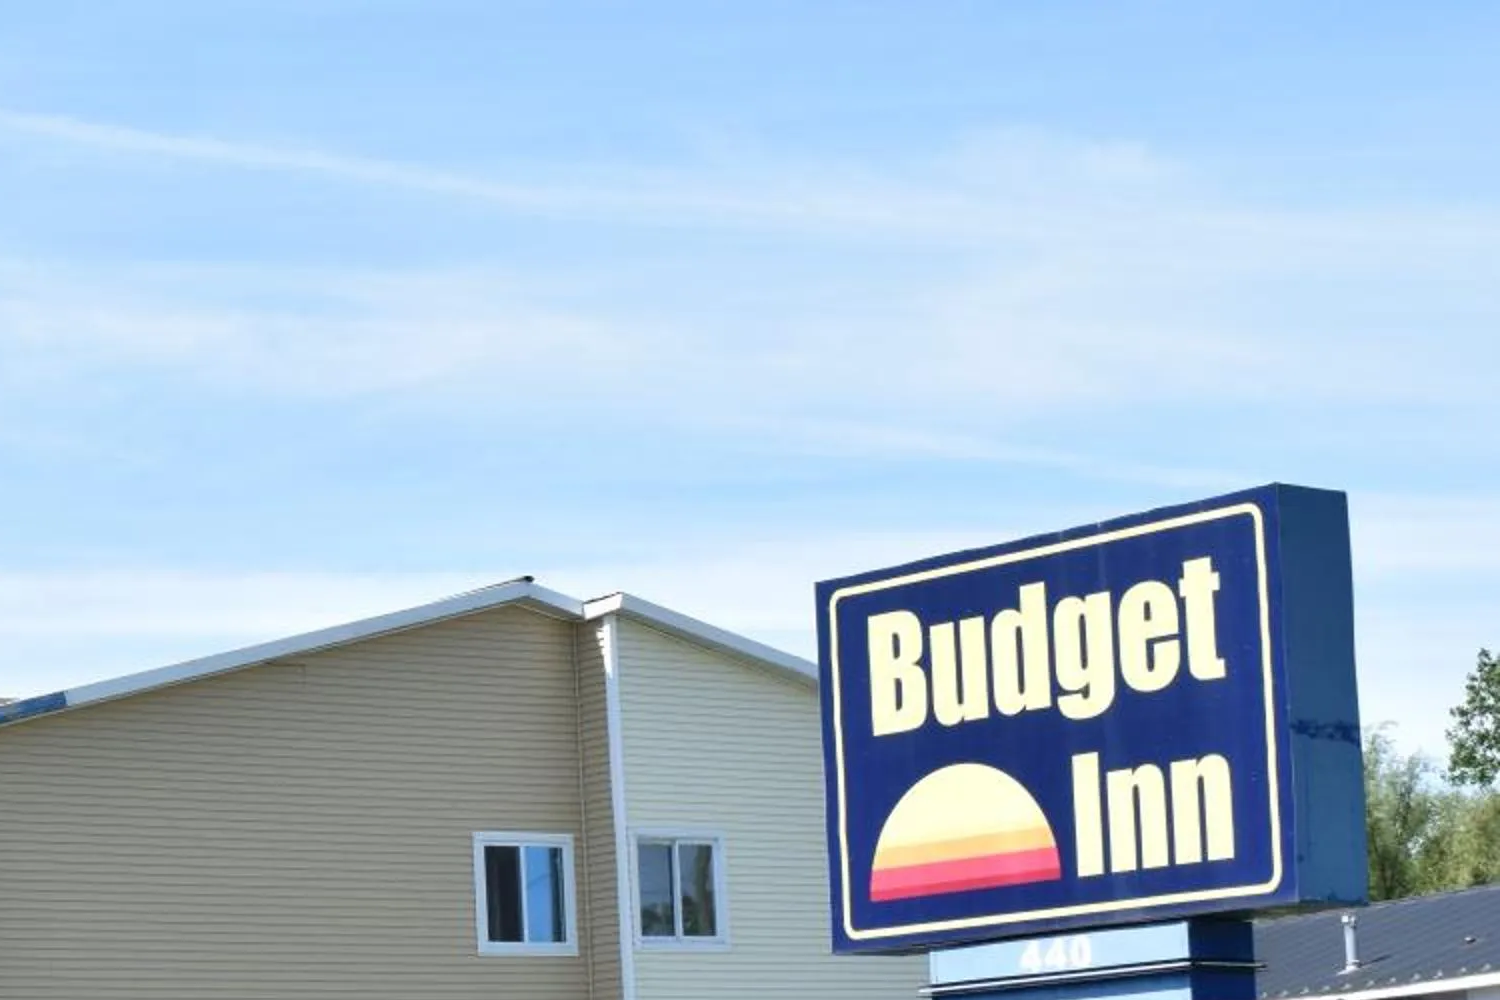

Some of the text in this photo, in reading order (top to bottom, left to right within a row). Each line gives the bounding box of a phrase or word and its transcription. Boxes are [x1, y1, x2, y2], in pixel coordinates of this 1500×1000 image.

[867, 556, 1227, 737] Budget
[1071, 751, 1235, 878] Inn
[1018, 934, 1093, 973] 440
